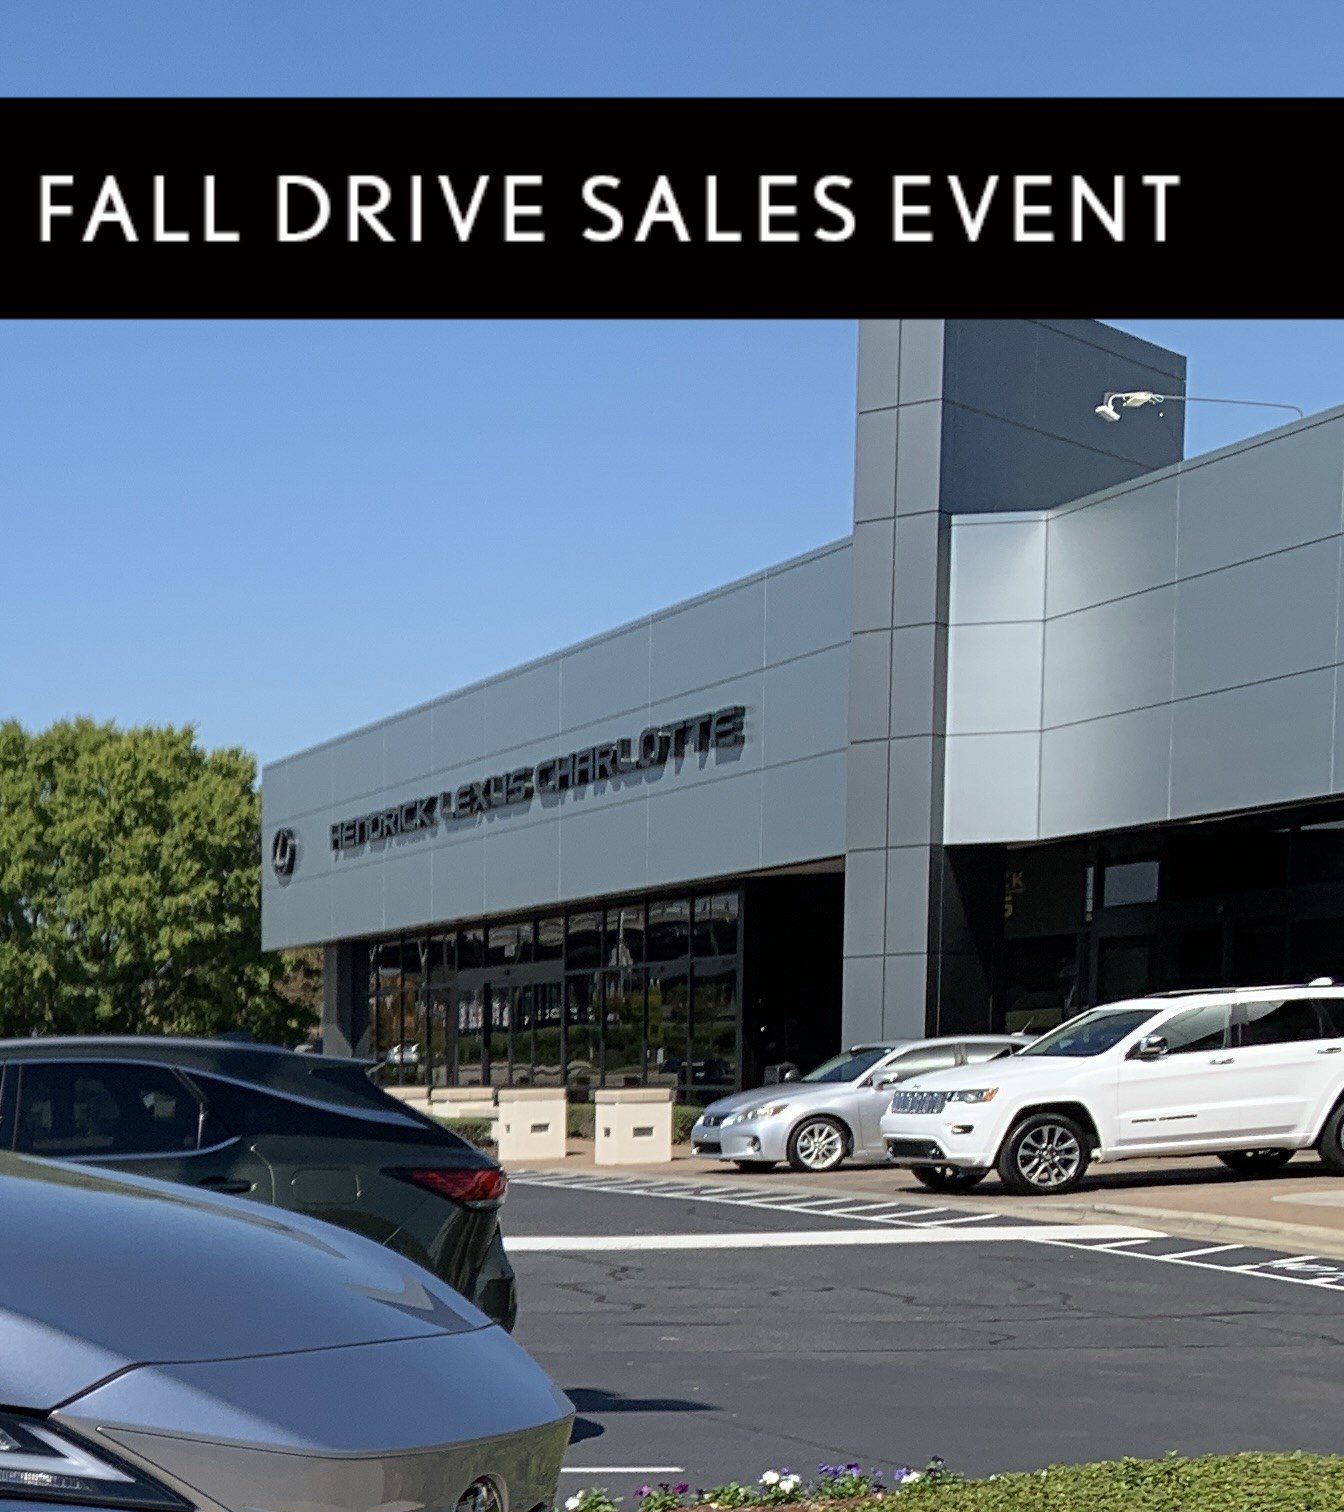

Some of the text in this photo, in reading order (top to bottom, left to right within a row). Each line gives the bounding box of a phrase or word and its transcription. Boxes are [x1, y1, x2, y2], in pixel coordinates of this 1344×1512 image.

[329, 705, 748, 852] HENDRICK LEXUS CHARLOTTE
